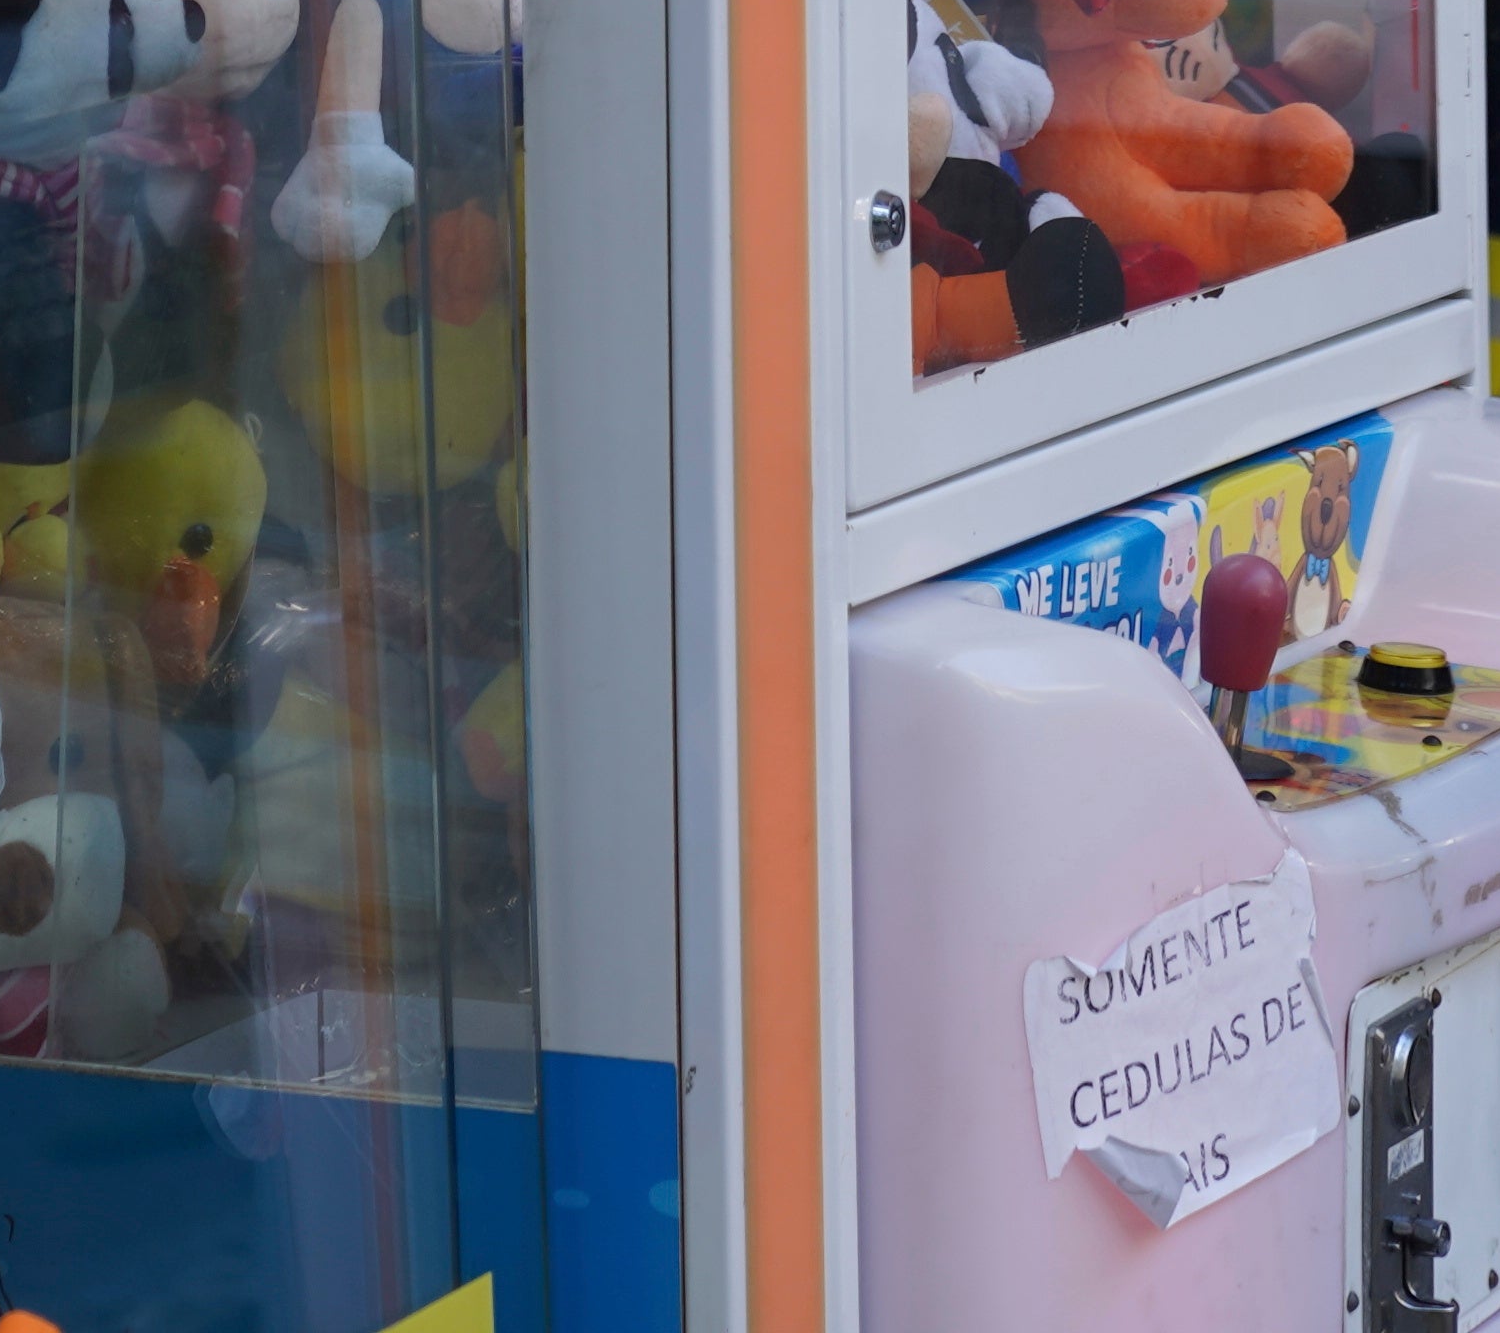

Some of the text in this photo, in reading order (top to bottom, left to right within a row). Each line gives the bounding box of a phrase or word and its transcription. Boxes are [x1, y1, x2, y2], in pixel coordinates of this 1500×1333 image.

[1016, 555, 1122, 618] ME LEVE
[1057, 900, 1256, 1025] SOMENTE
[1069, 982, 1307, 1129] CEDULAS DE
[1178, 1133, 1231, 1193] AIS
